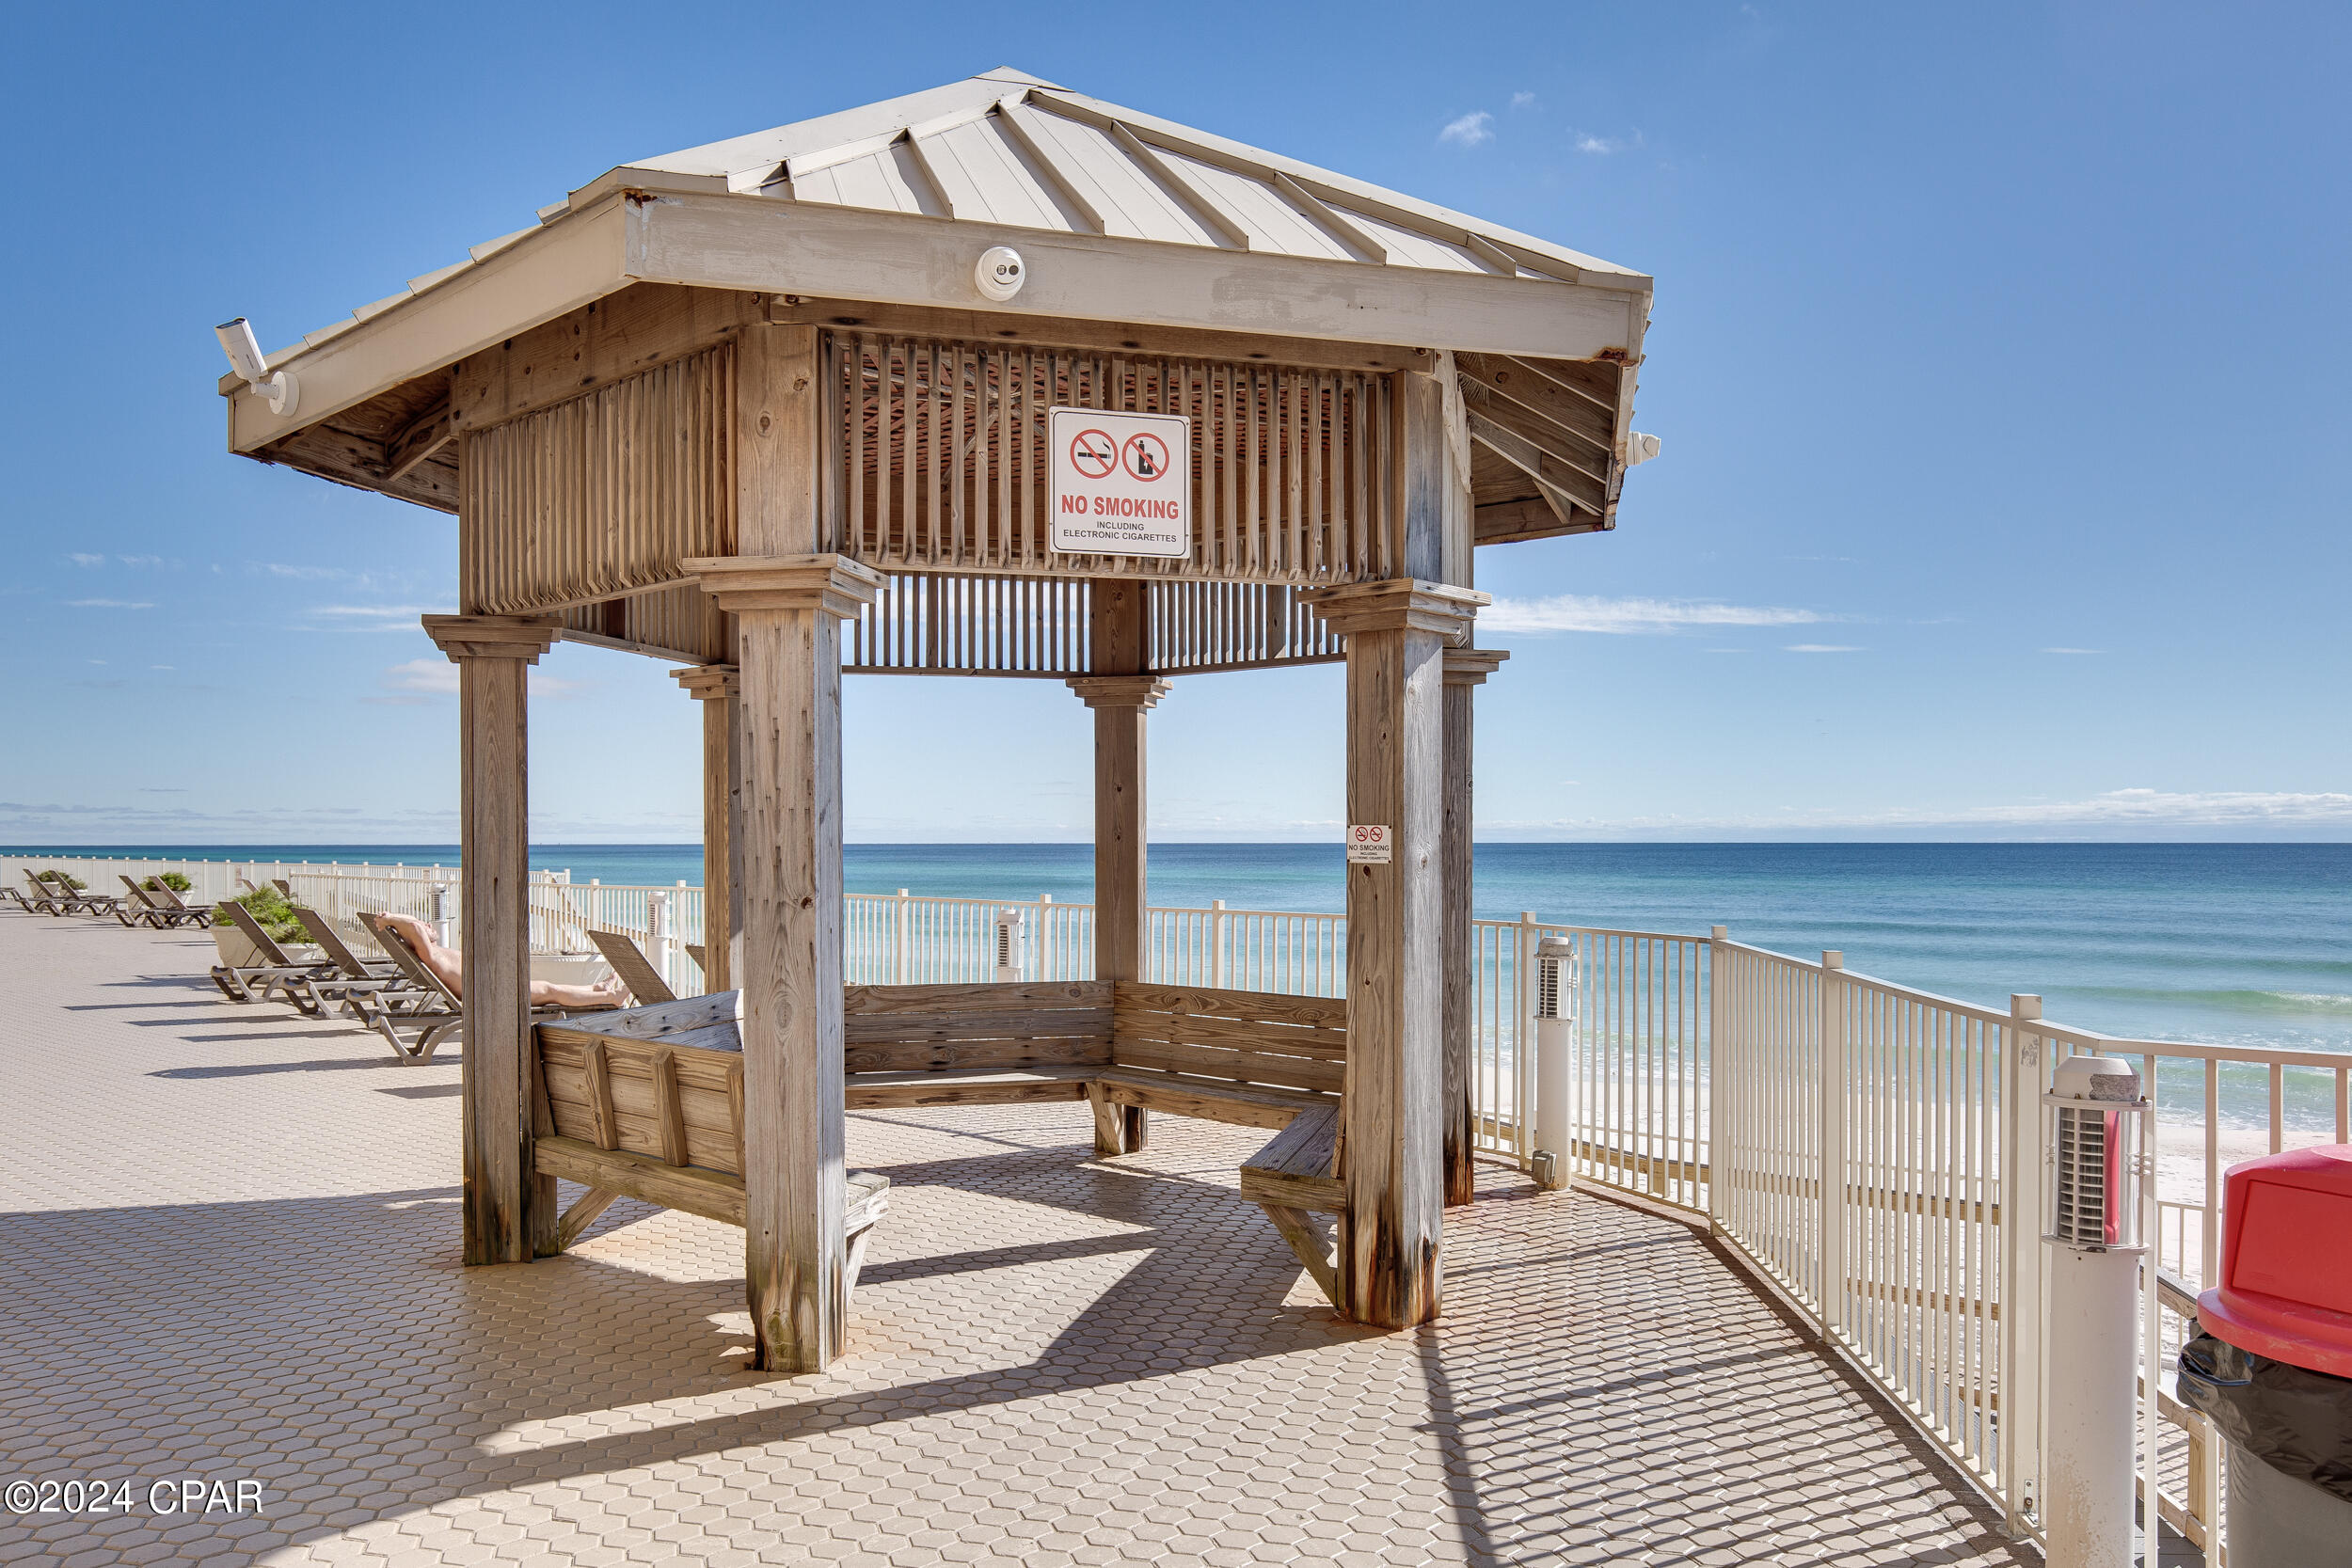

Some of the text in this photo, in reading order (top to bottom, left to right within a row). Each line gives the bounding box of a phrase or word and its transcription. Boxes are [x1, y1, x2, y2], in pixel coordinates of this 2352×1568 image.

[1061, 494, 1179, 519] NO SMOKING
[1096, 521, 1145, 531] INCLUDING
[1063, 530, 1177, 543] ELECTRONIC CIGARETTES
